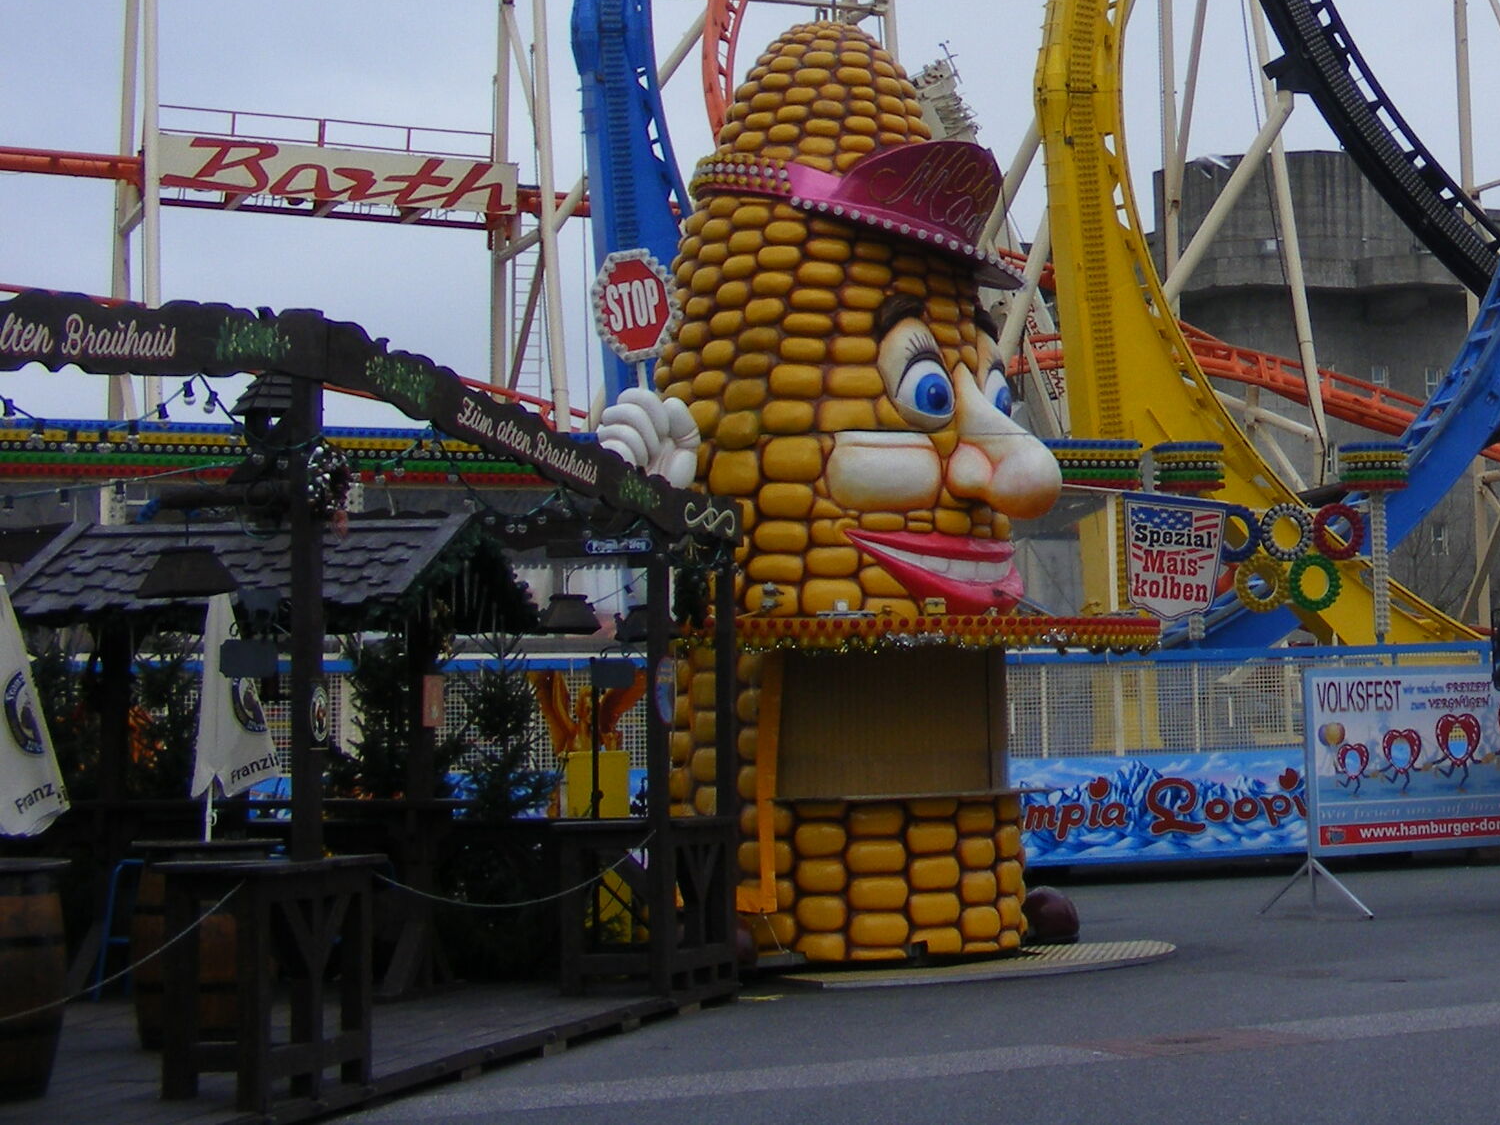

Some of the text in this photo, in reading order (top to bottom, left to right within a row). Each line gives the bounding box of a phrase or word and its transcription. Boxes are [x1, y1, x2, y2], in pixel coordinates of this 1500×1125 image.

[160, 137, 514, 213] Barth
[606, 278, 659, 332] STOP
[497, 420, 532, 455] alten
[1134, 523, 1213, 549] Spezial
[1143, 549, 1204, 576] Mais-
[1134, 573, 1208, 603] kolben
[1316, 680, 1401, 713] VOLKSFEST
